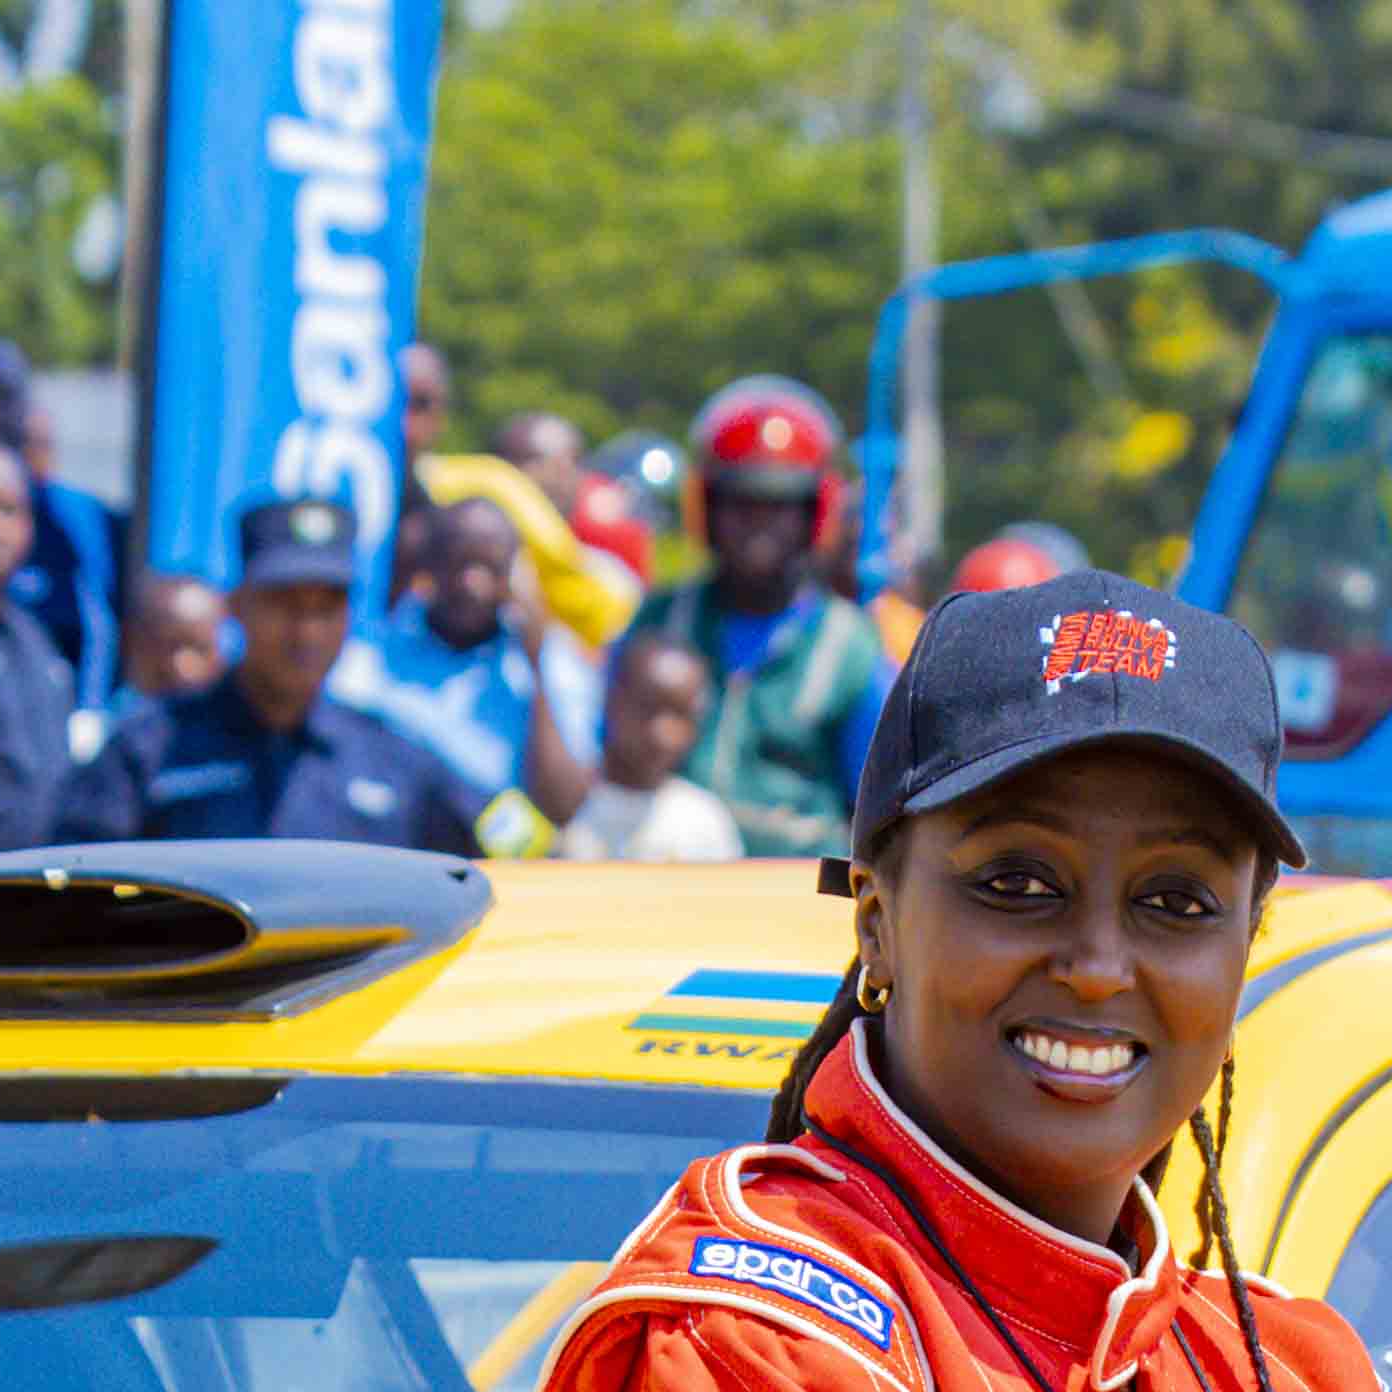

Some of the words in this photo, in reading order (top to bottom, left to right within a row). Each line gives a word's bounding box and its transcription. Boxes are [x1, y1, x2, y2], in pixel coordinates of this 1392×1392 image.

[266, 0, 397, 560] sanla
[1078, 651, 1165, 684] TEAM
[702, 1242, 885, 1334] sparco
